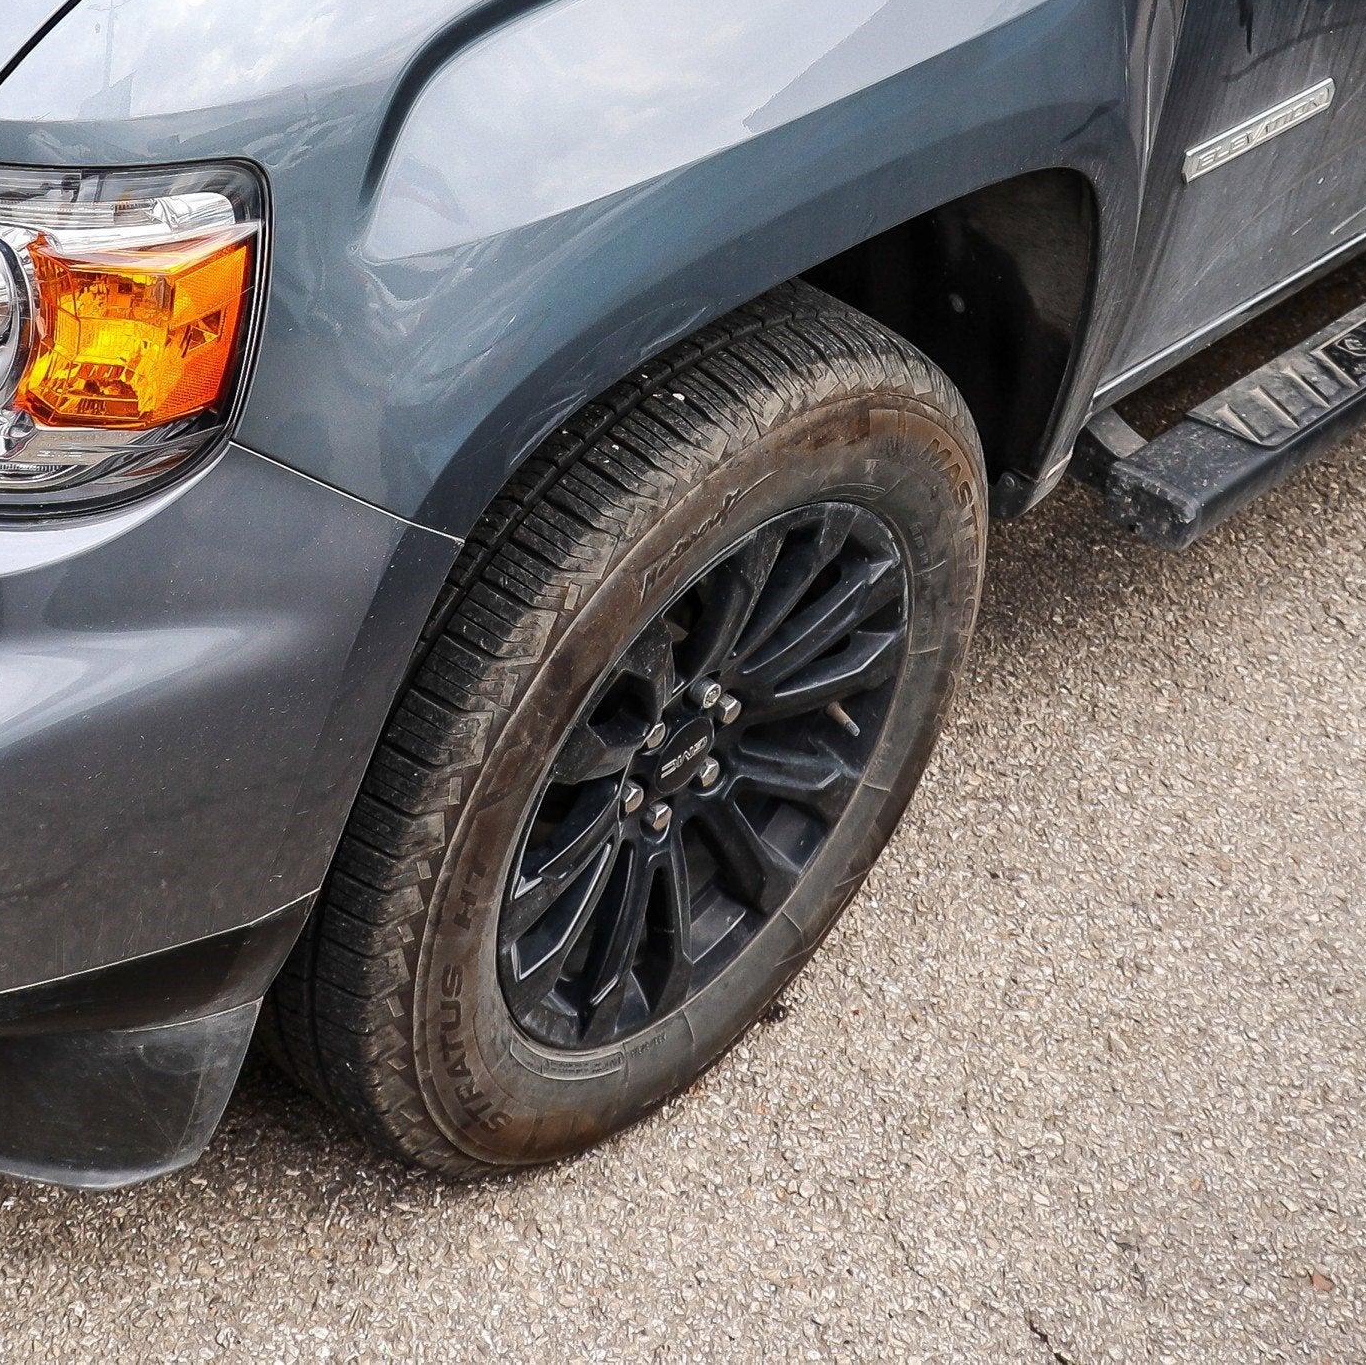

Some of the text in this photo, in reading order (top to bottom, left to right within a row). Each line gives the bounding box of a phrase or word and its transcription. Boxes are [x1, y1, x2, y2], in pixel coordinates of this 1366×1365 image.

[1196, 88, 1331, 171] ELEVATION
[660, 735, 708, 779] GMC
[439, 850, 513, 1133] STRATUS HT
